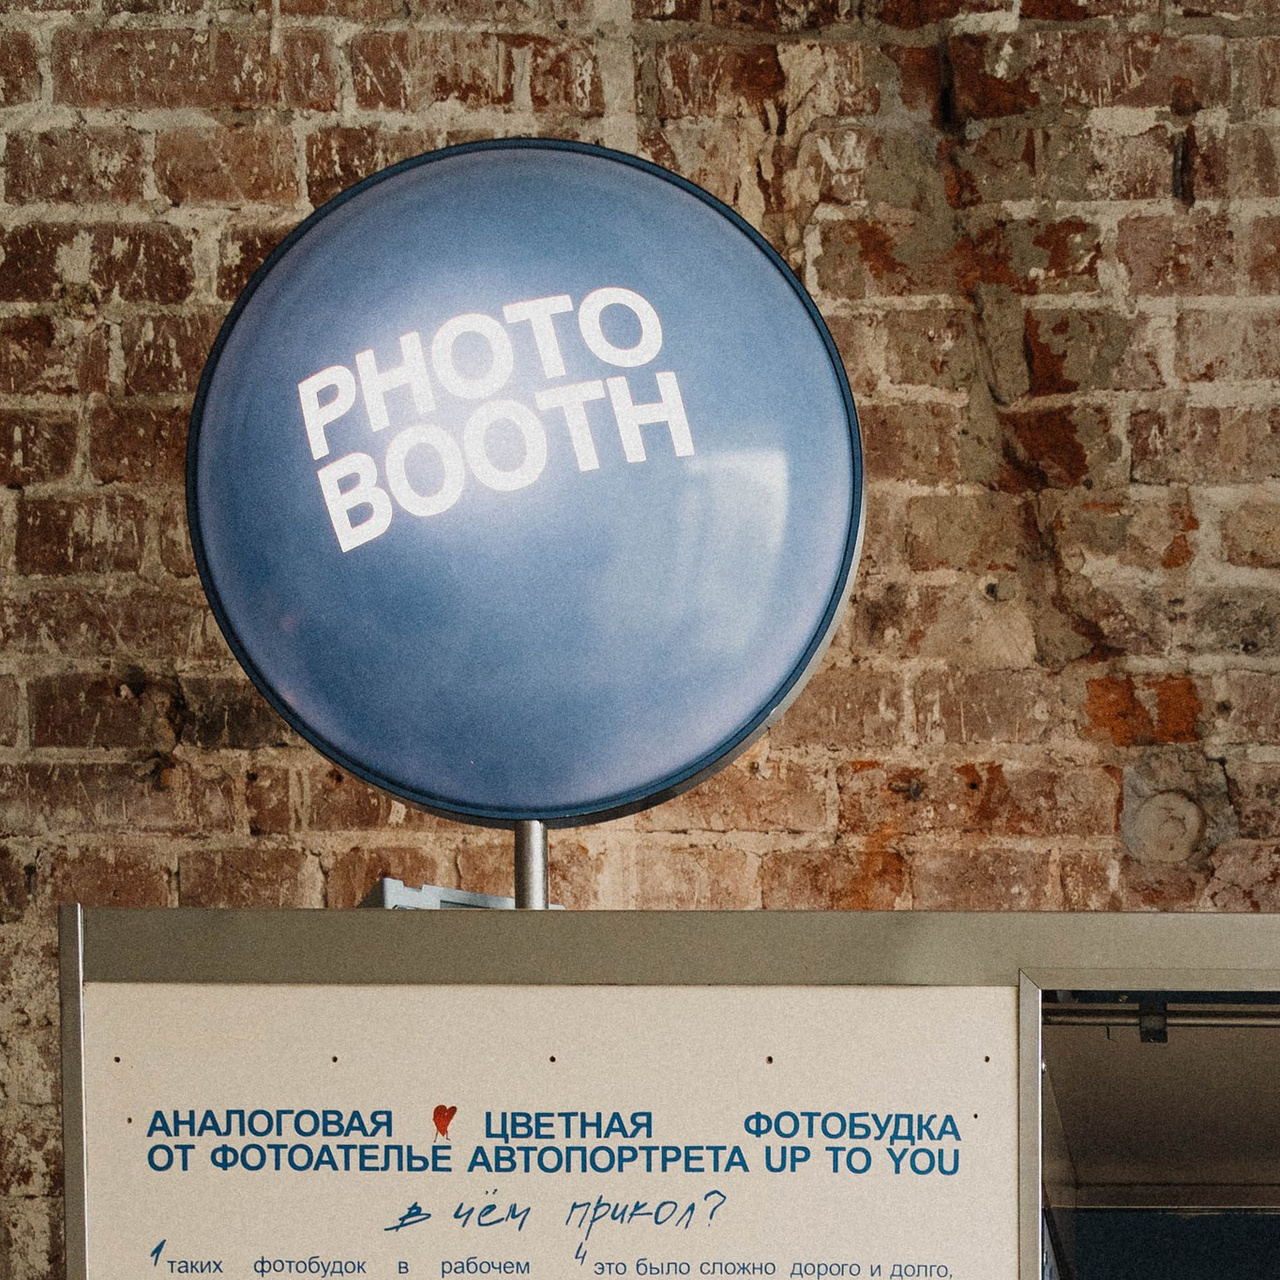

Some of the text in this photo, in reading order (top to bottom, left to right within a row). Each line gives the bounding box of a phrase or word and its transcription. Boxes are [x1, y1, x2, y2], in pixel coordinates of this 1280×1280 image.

[298, 287, 662, 460] PHOTO
[317, 371, 695, 553] BOOTH
[146, 1109, 961, 1145] АНАЛОГОВАЯ ЦВЕТНАЯ ФОТОБУДКА
[147, 1143, 959, 1176] ОТ ФОТОАТЕЛЬЕ АВТОПОРТРЕТА UP TO YOU
[565, 1189, 726, 1240] прикол?
[150, 1239, 166, 1266] 1
[167, 1255, 530, 1278] таких фотобудок в рабочем
[594, 1257, 953, 1280] это было сложно дорого и долго,
